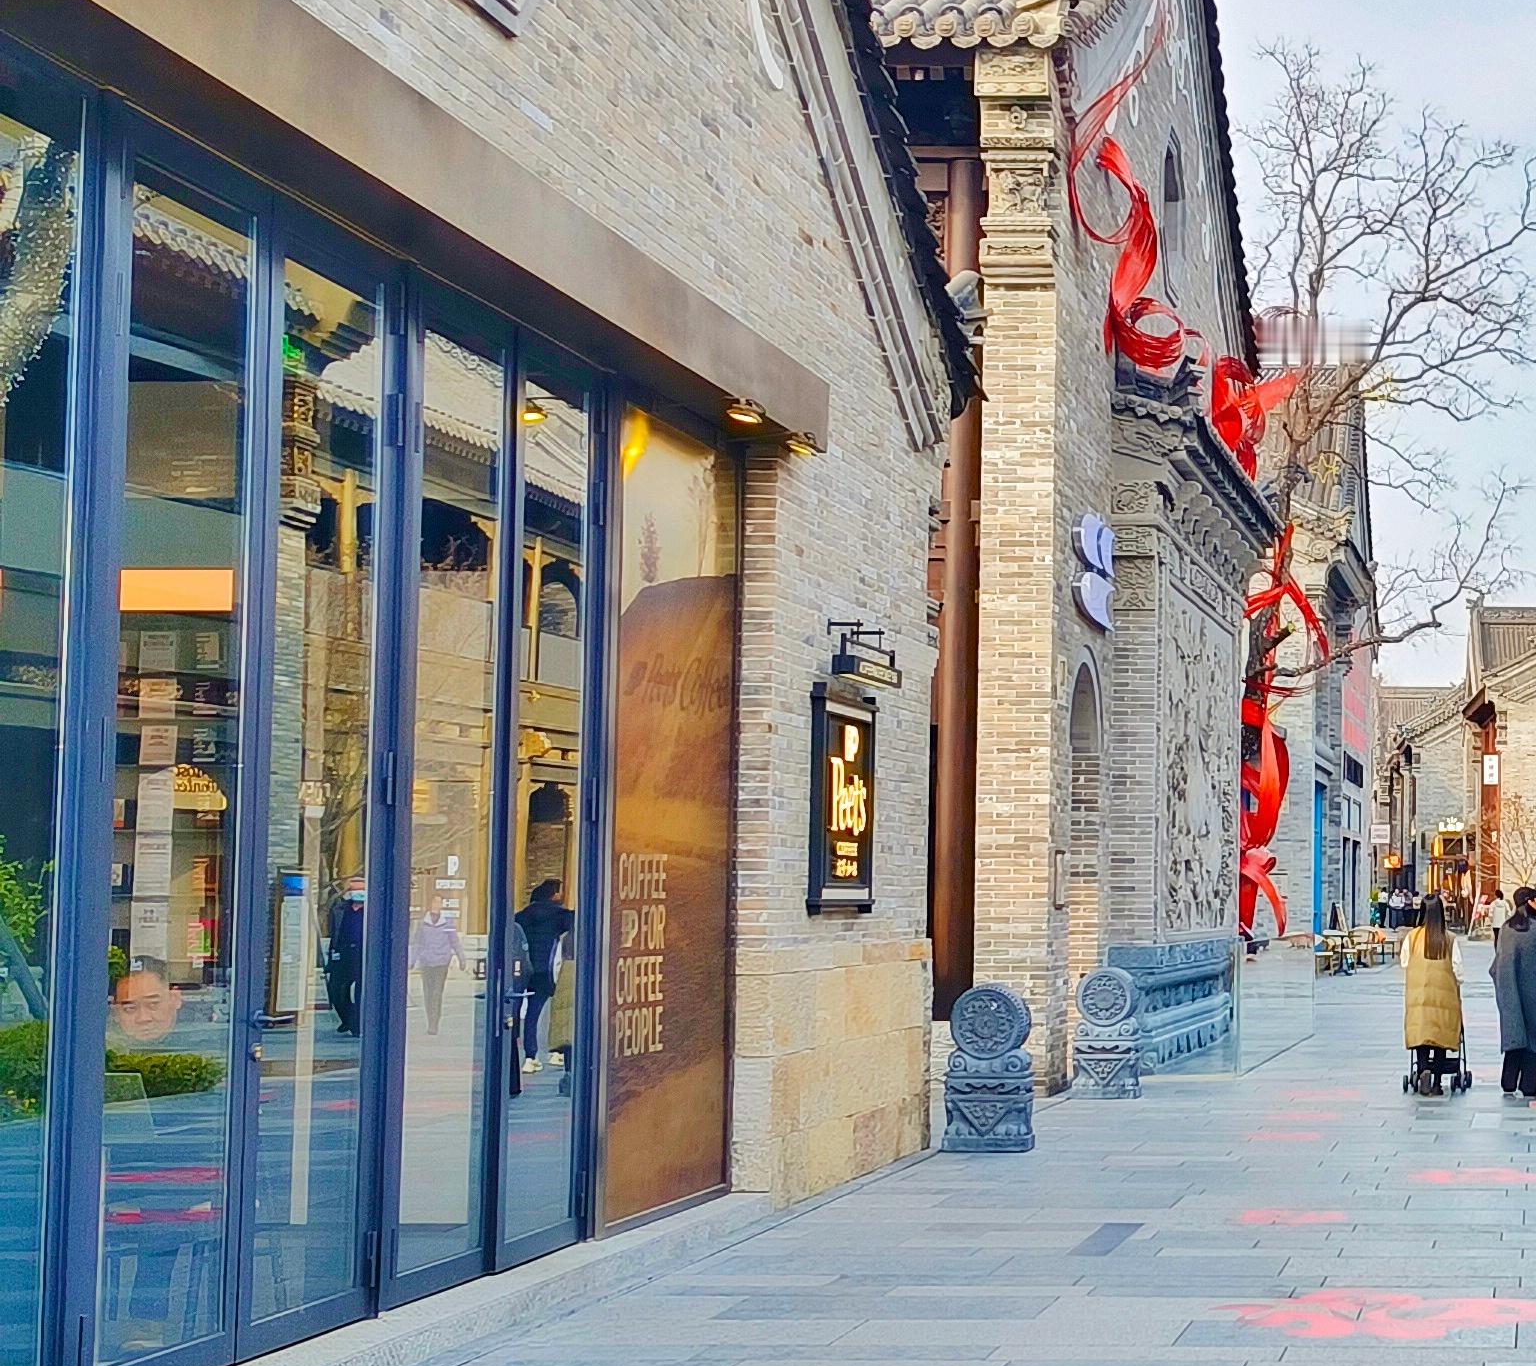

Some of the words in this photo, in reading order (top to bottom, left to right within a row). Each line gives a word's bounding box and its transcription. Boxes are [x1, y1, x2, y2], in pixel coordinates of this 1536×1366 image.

[618, 852, 668, 900] COFFEE
[640, 904, 666, 950] FOR
[615, 955, 663, 1005] COFFEE
[614, 1005, 663, 1059] PEOPLE
